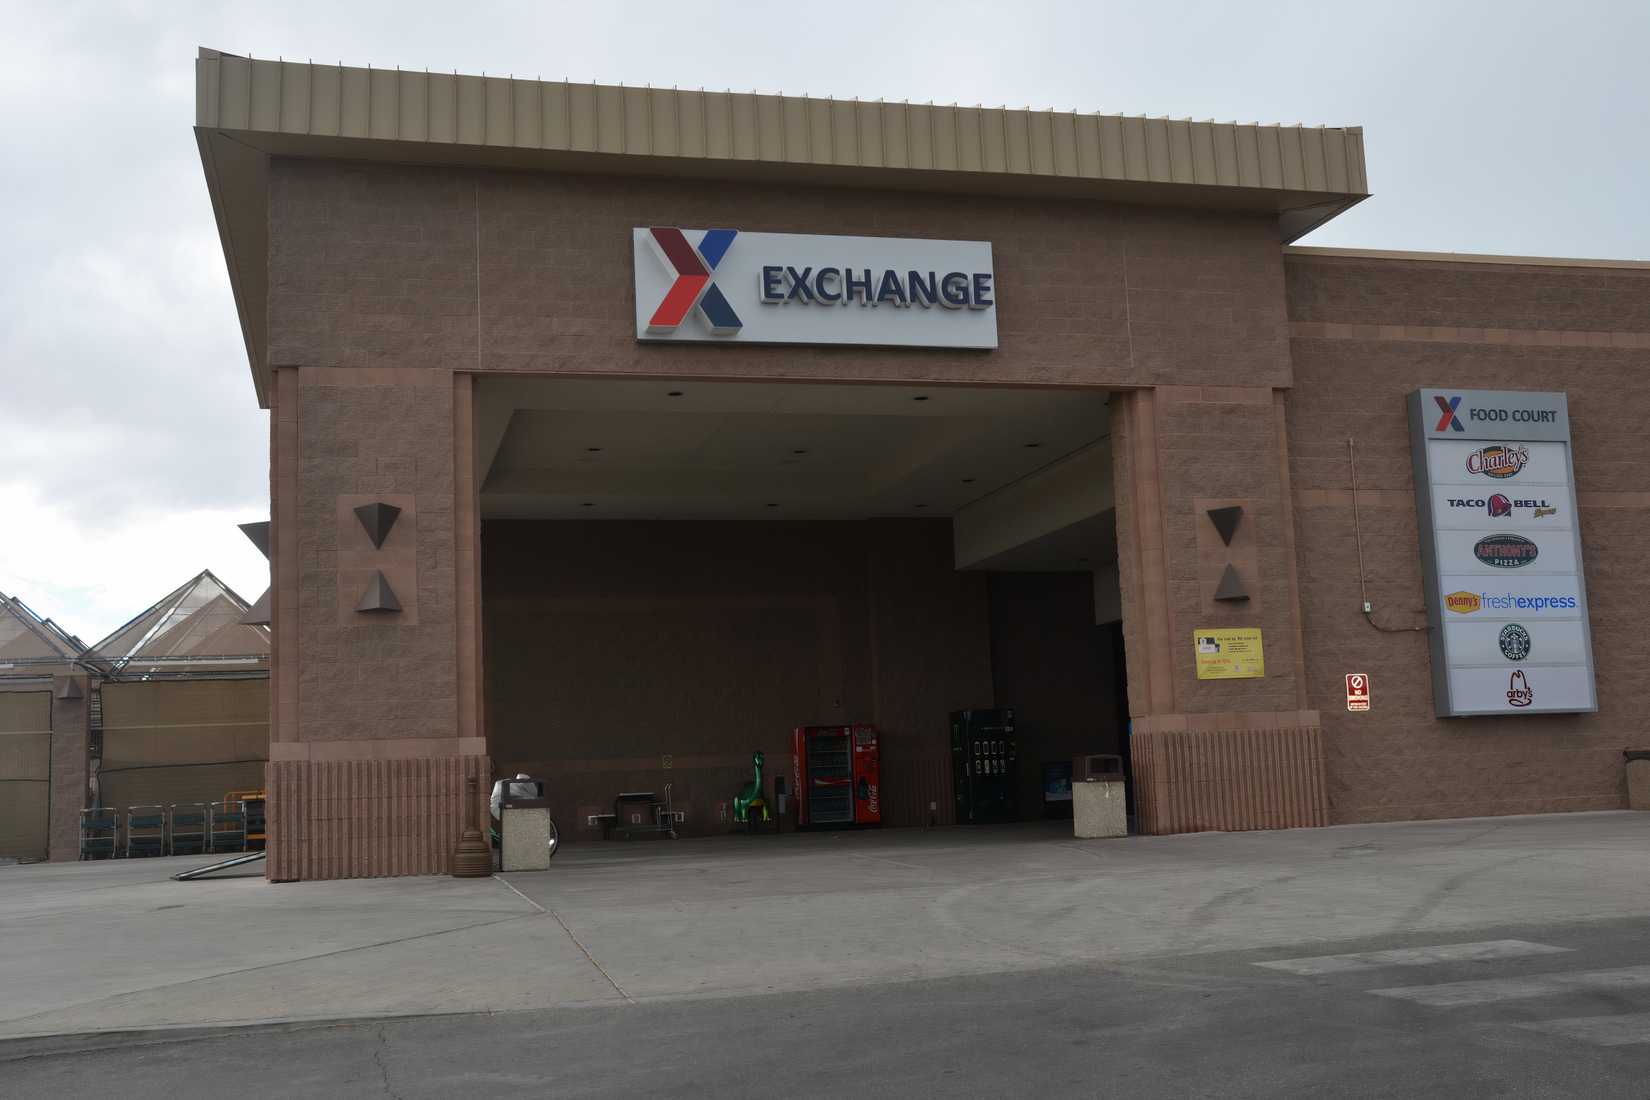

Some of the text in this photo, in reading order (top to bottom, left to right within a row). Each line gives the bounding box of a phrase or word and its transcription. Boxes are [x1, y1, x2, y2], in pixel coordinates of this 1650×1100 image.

[761, 265, 995, 309] EXCHANGE
[1469, 408, 1508, 422] FOOD
[1512, 409, 1557, 423] COURT
[1466, 447, 1529, 474] Charley's
[1447, 499, 1550, 508] TACO BELL
[1494, 558, 1520, 566] PIZZA
[1447, 595, 1480, 608] Denny's
[1506, 686, 1533, 699] arby's
